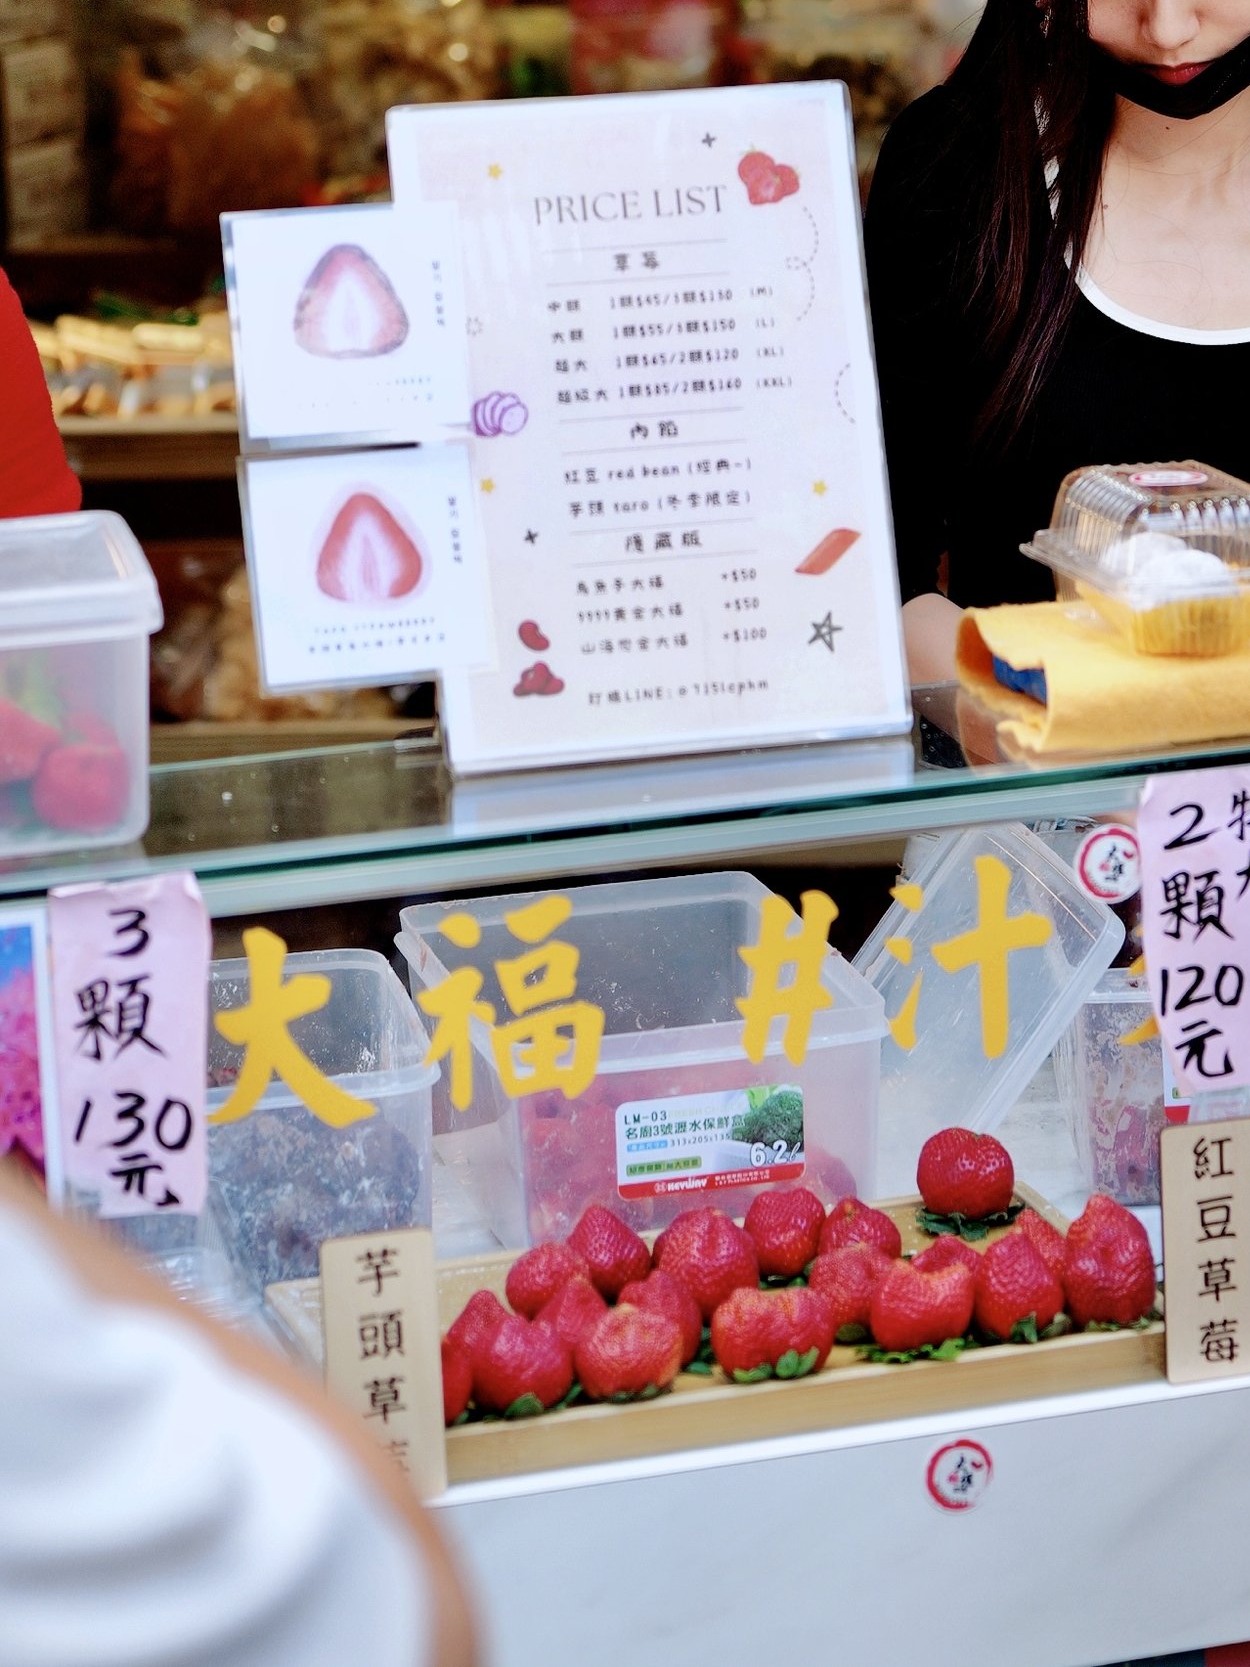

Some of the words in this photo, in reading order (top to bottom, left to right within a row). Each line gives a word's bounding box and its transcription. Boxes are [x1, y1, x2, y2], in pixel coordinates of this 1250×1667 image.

[534, 191, 642, 224] PRICE
[654, 186, 726, 217] LIST
[614, 251, 659, 271] 草莓
[608, 466, 635, 480] red
[642, 464, 680, 477] bean
[614, 501, 649, 513] taro
[207, 895, 605, 1128] 大福
[624, 1110, 667, 1125] LM-03
[1193, 1137, 1239, 1362] 紅豆草莓
